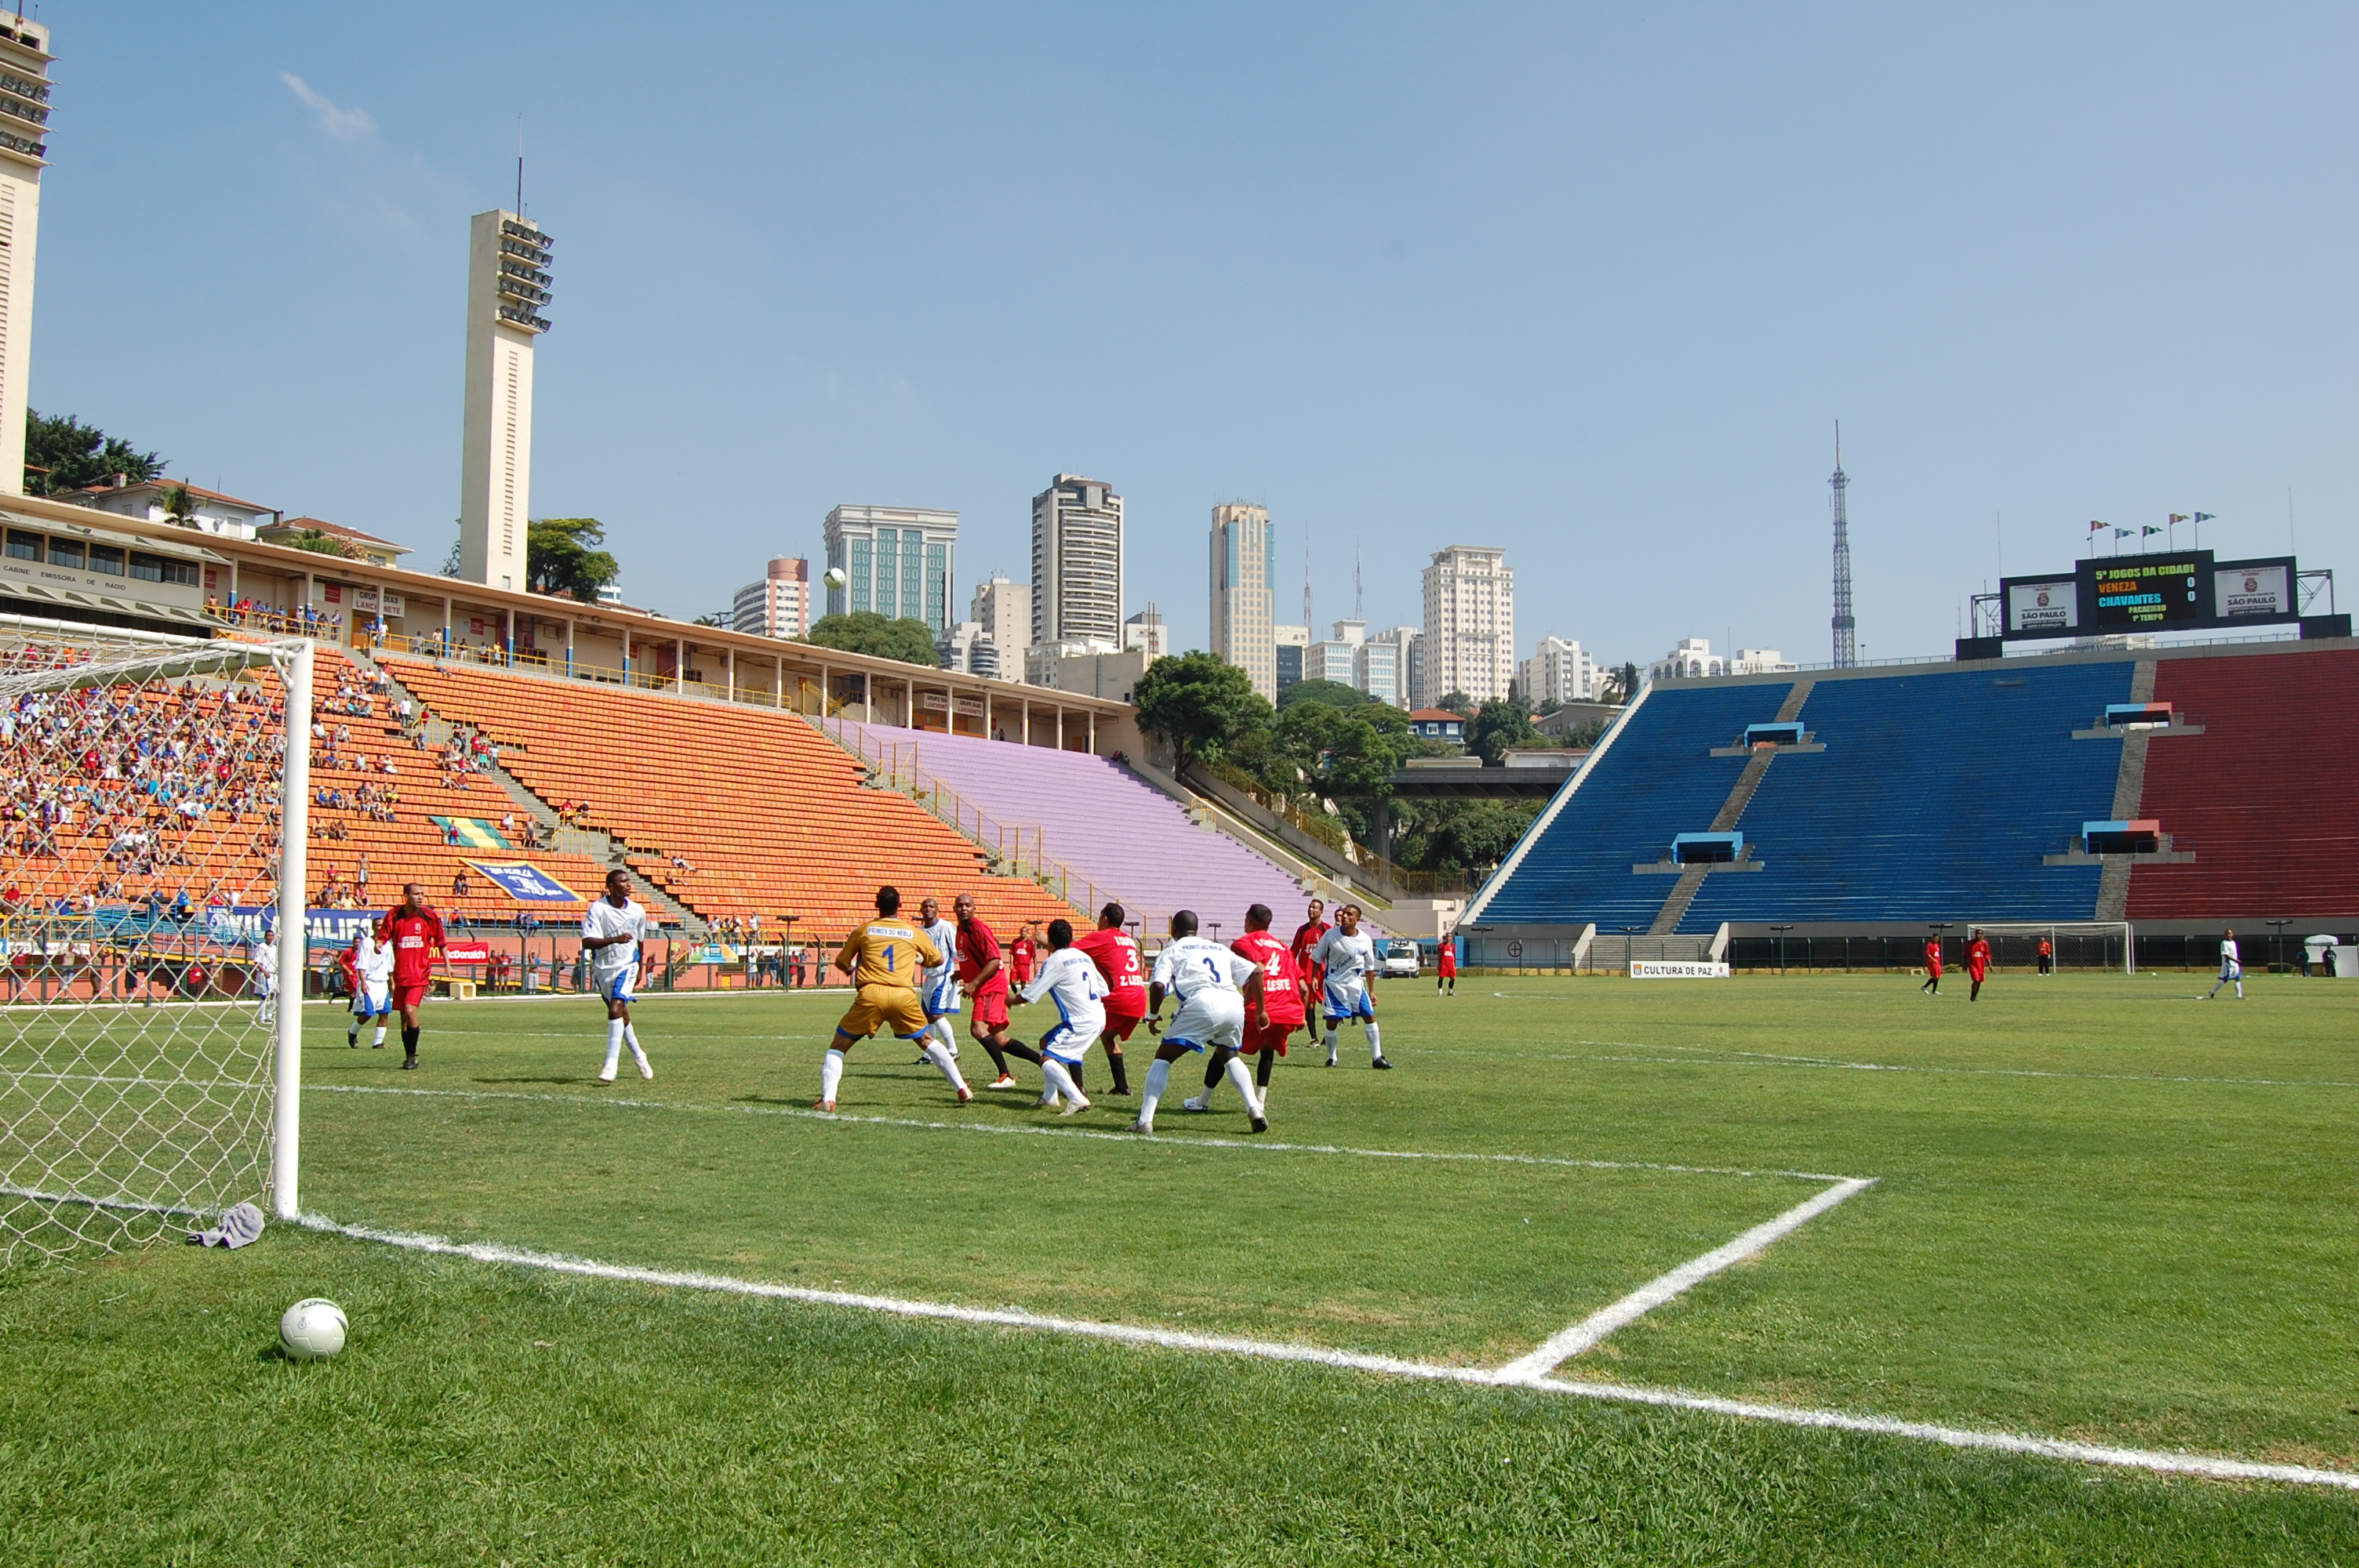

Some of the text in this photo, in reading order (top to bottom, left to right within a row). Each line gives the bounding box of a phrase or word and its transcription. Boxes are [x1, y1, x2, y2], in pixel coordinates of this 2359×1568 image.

[3, 565, 30, 575] CABINE
[41, 572, 76, 583] EMISSORA
[2109, 568, 2141, 579] JOGOS
[2142, 567, 2157, 576] DA
[2158, 564, 2195, 575] CIDADE
[2098, 576, 2195, 593] VENEZA 0
[359, 591, 376, 601] GRUP
[2099, 590, 2196, 607] CHAVANTES 0
[2227, 596, 2276, 606] SÃO PAULO
[881, 944, 895, 972] 1
[1125, 949, 1138, 972] 3
[1264, 951, 1281, 976] 4
[1203, 957, 1220, 983] 3
[1644, 966, 1683, 975] CULTURA
[1082, 971, 1097, 1000] 2
[1266, 980, 1291, 991] LESTE
